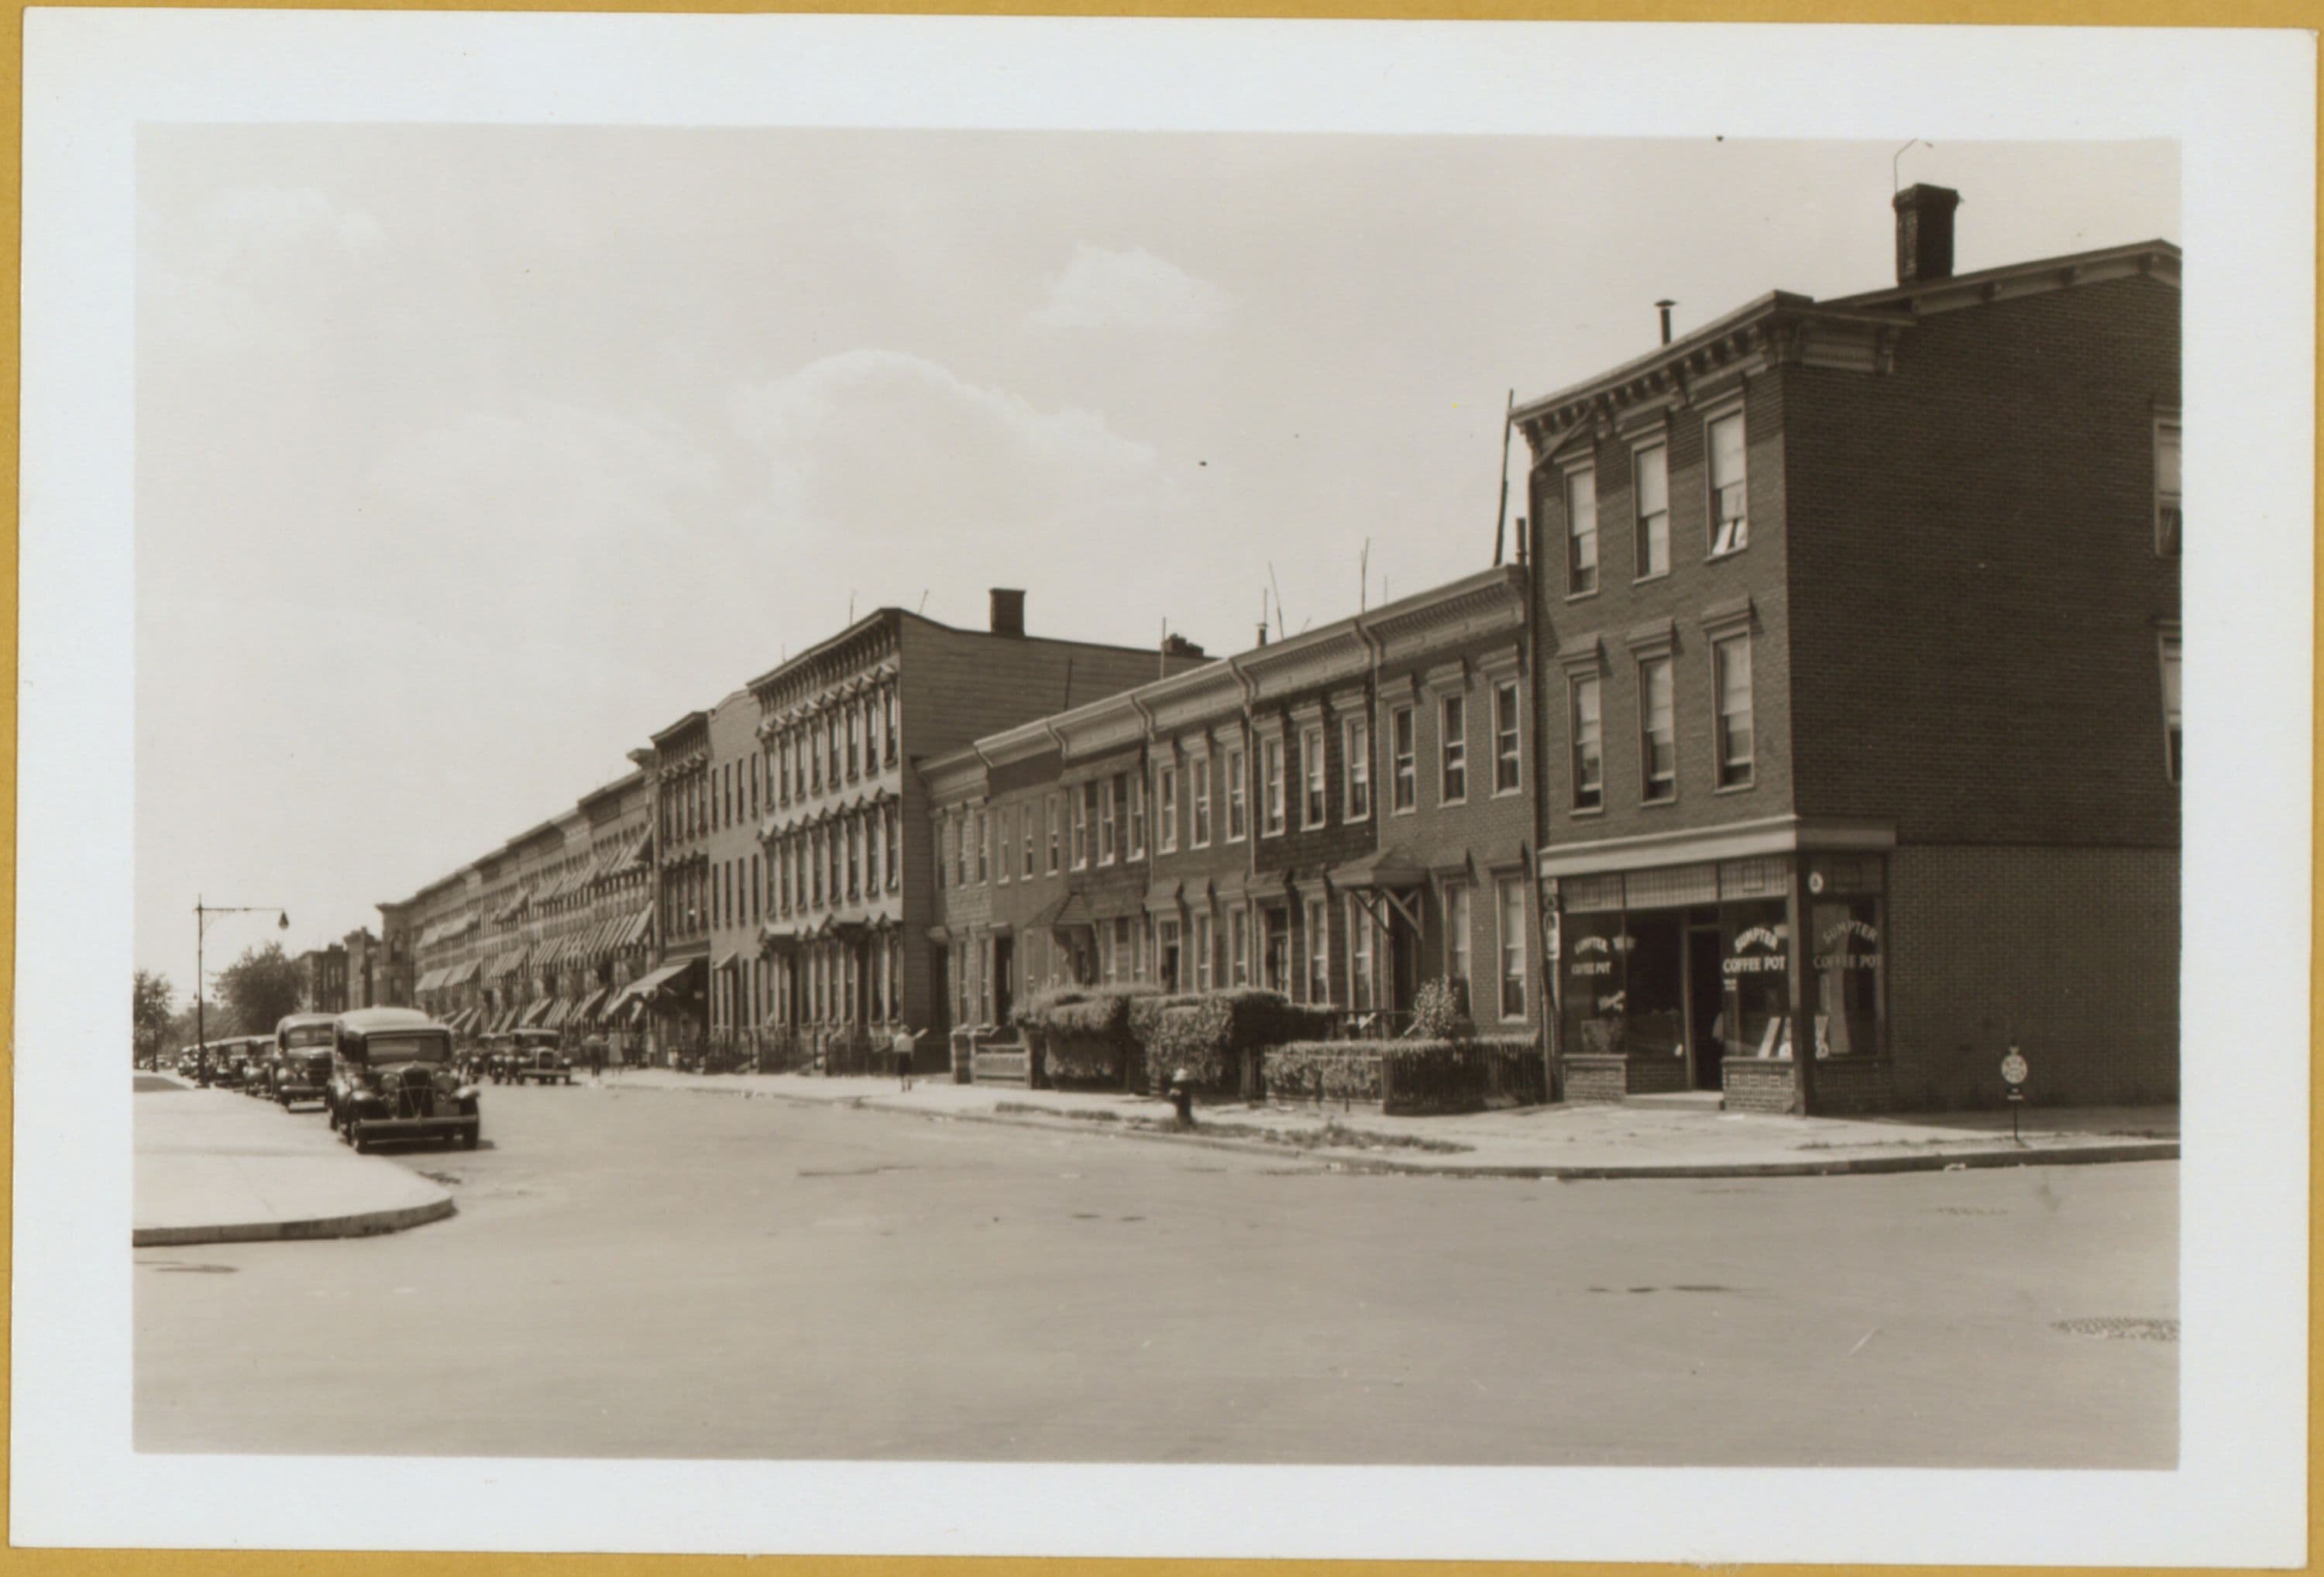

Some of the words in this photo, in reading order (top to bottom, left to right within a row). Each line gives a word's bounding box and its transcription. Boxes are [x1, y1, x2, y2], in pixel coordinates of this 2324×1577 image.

[1735, 927, 1779, 953] SUMPTER
[1822, 921, 1878, 943] SUMPTER
[1596, 961, 1611, 974] POT
[1723, 957, 1762, 974] COFFEE
[1763, 955, 1786, 971] POT
[1813, 953, 1856, 968] COFFEE
